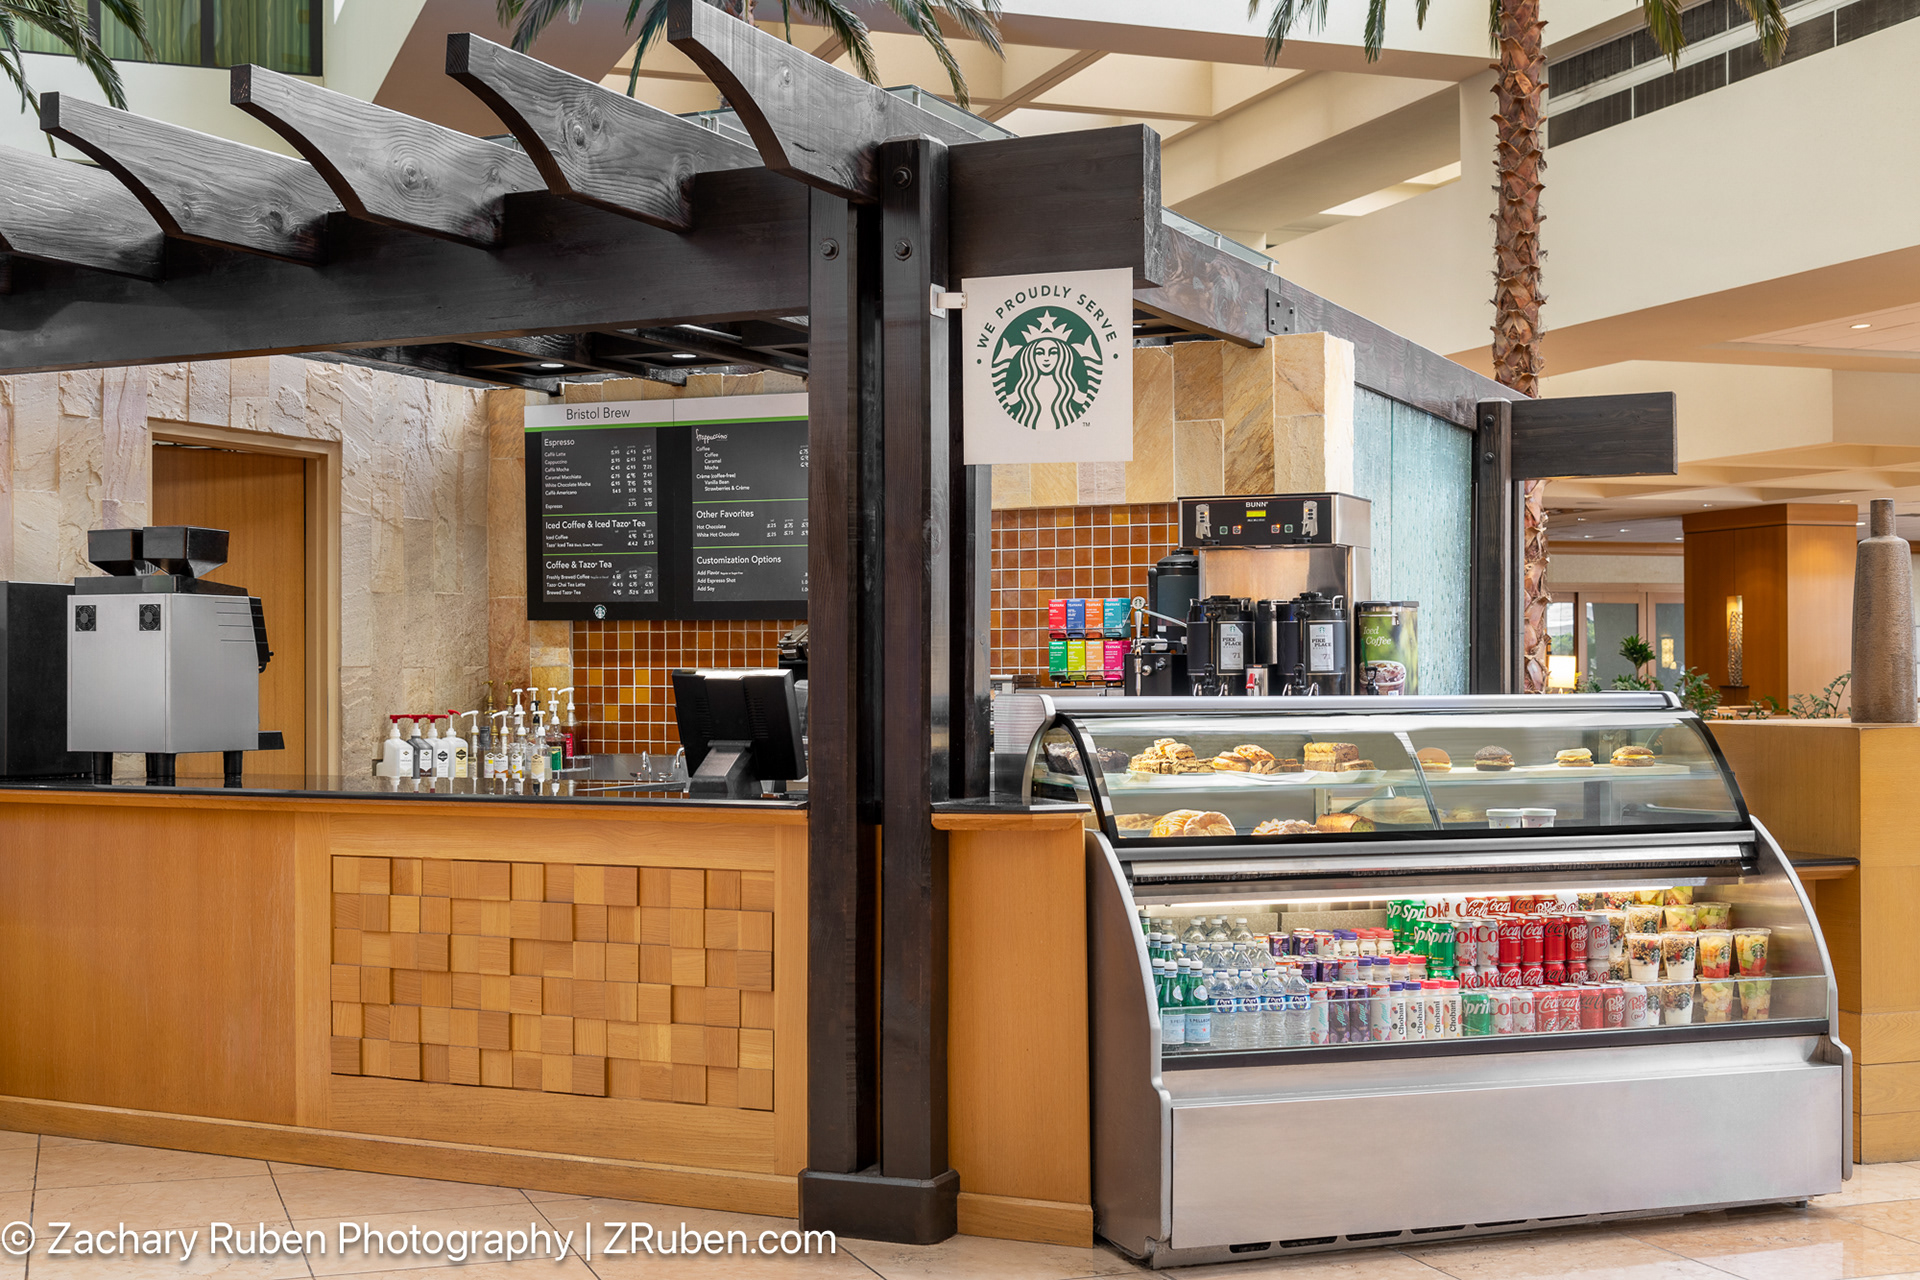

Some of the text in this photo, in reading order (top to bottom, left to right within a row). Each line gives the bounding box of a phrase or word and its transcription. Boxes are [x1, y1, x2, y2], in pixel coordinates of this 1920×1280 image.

[977, 286, 1117, 348] WE PROUDLY SERVE
[567, 406, 631, 420] Bristol Brew
[544, 439, 575, 448] Espresso
[696, 510, 754, 518] Other Favorites
[546, 521, 560, 529] Iced
[562, 520, 586, 529] Coffee
[595, 520, 610, 528] Iced
[632, 519, 646, 527] Tea
[546, 561, 570, 569] Coffee
[571, 561, 577, 569] &
[697, 556, 781, 565] Customization Options
[1363, 626, 1379, 635] Iced
[1366, 637, 1392, 646] Coffee
